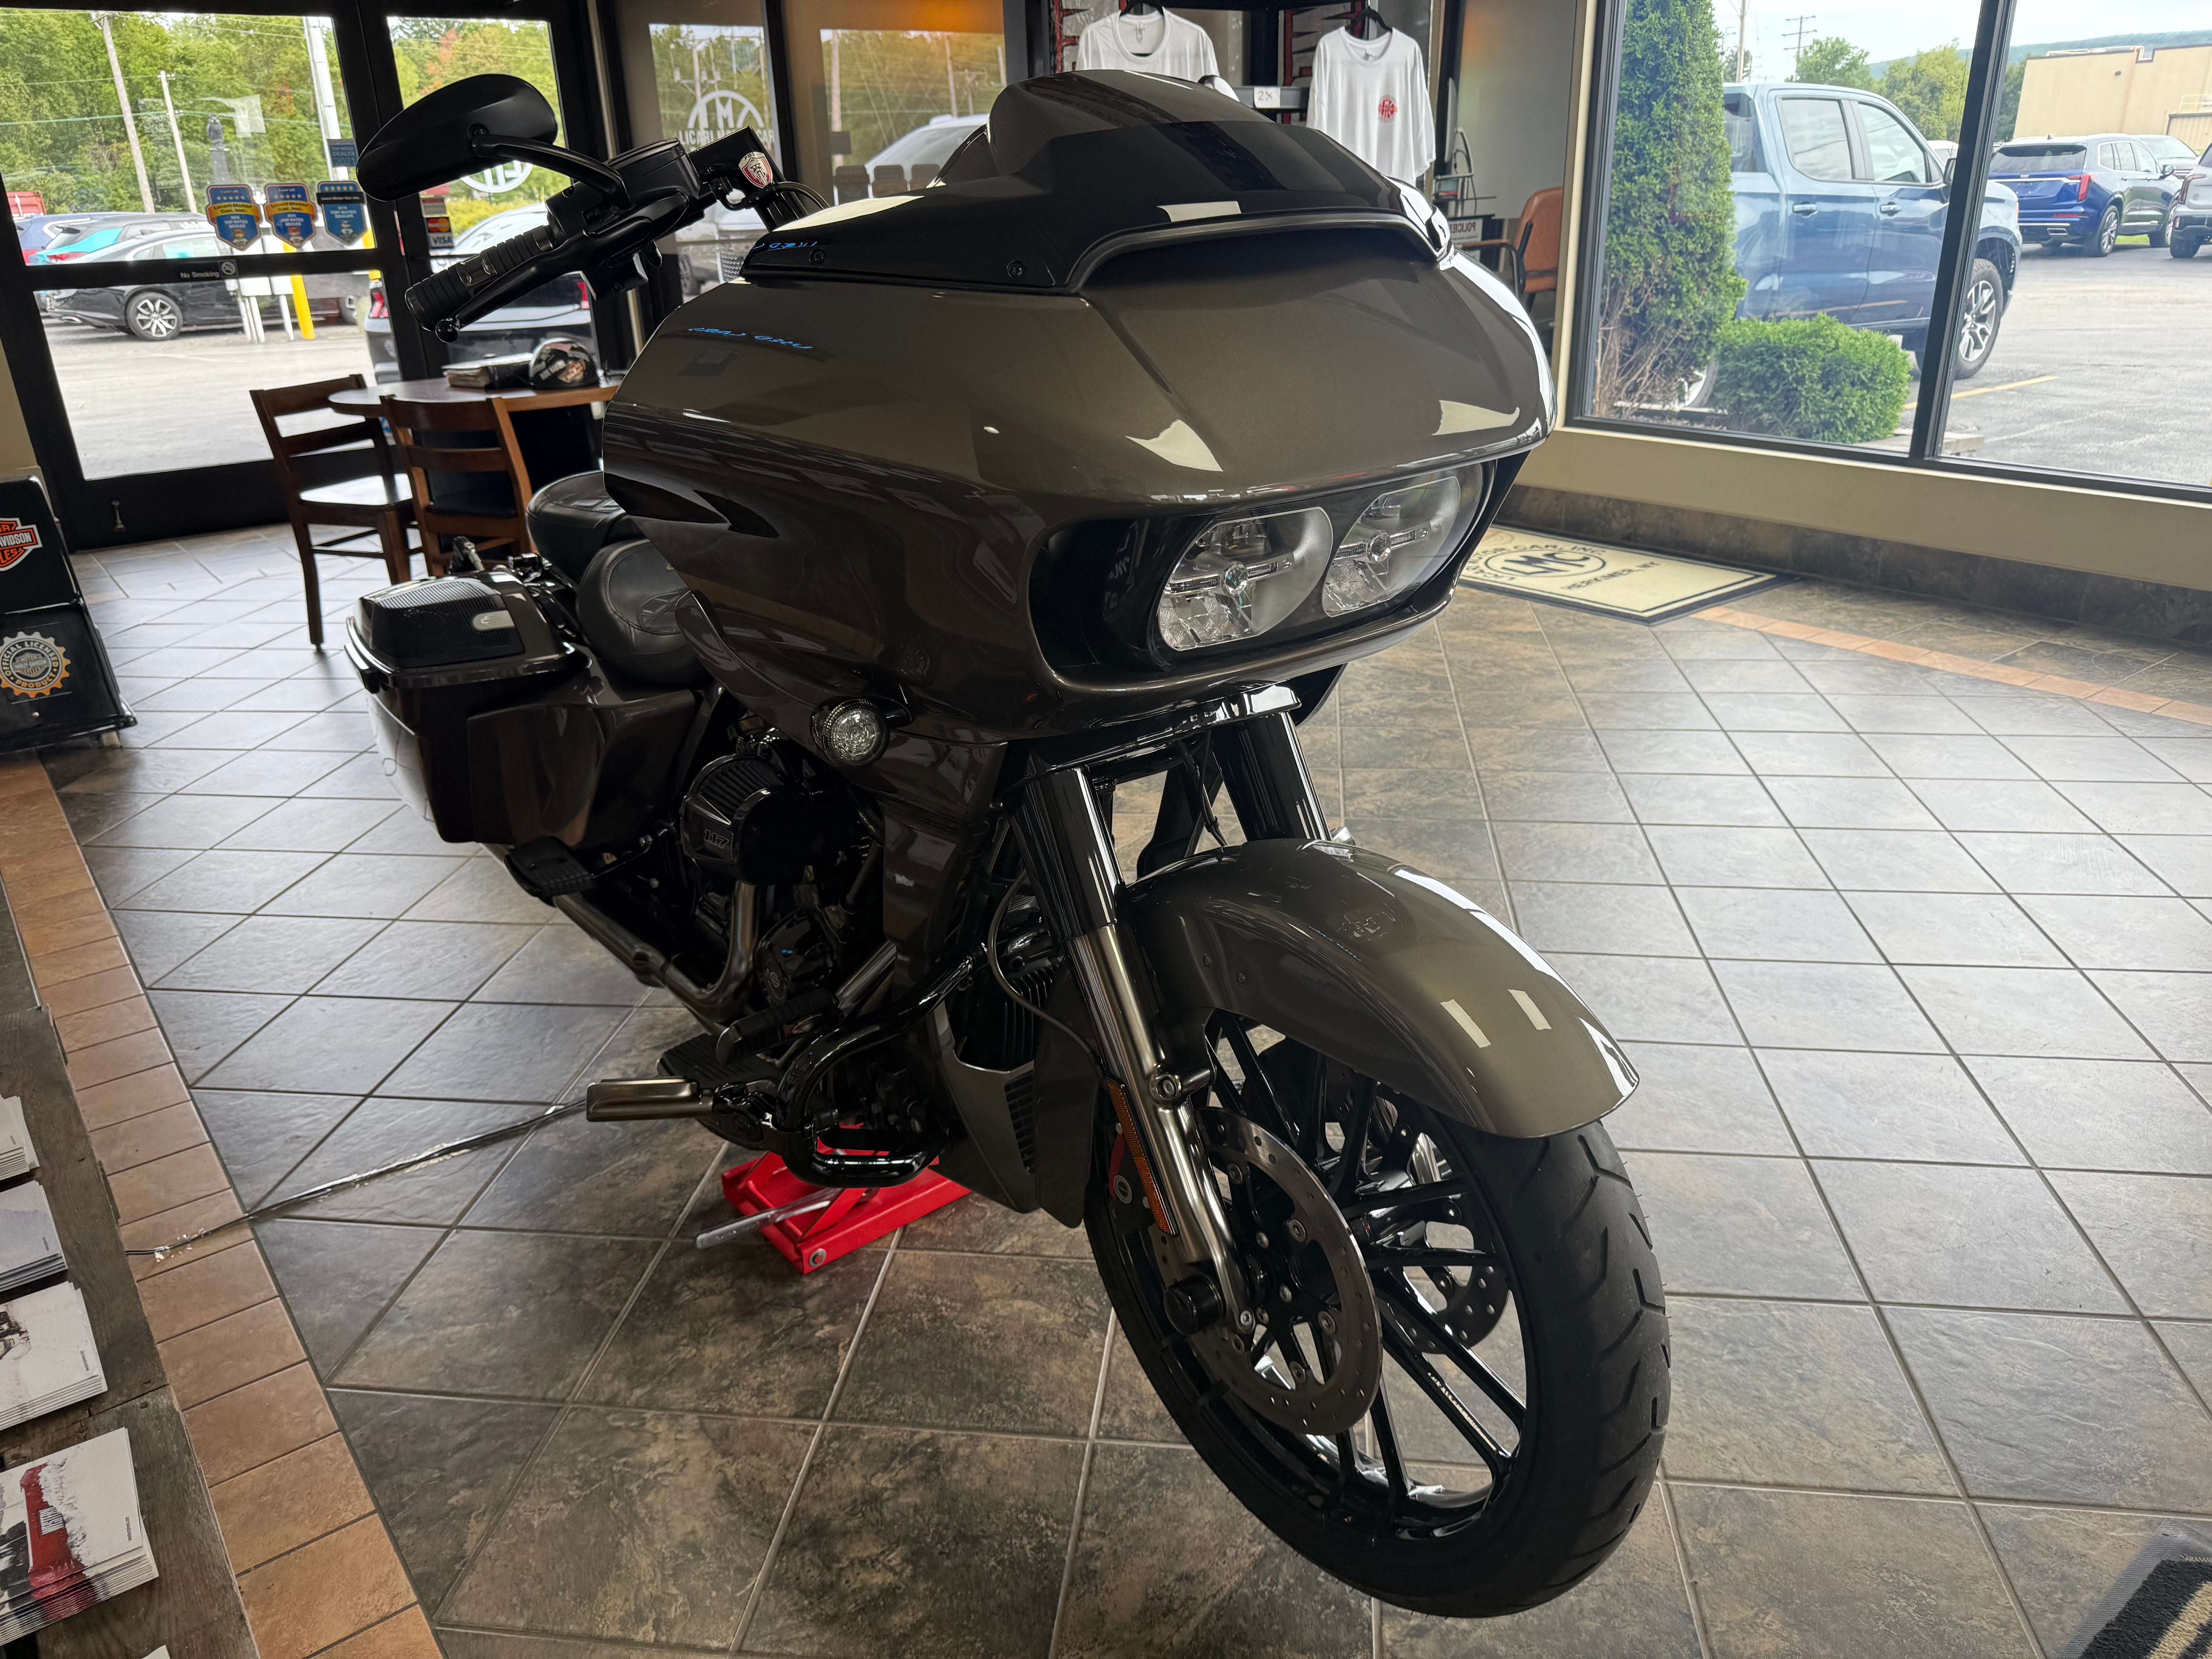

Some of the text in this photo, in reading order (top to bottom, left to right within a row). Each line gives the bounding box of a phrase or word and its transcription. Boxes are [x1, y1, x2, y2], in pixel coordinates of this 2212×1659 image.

[1258, 91, 1273, 101] 2X
[678, 129, 714, 145] LICARI
[433, 236, 452, 245] VISA
[1500, 552, 1590, 576] LMC
[2, 641, 59, 677] OFFICIAL LICENSED
[15, 672, 56, 689] PRODUCT
[704, 829, 729, 849] 117
